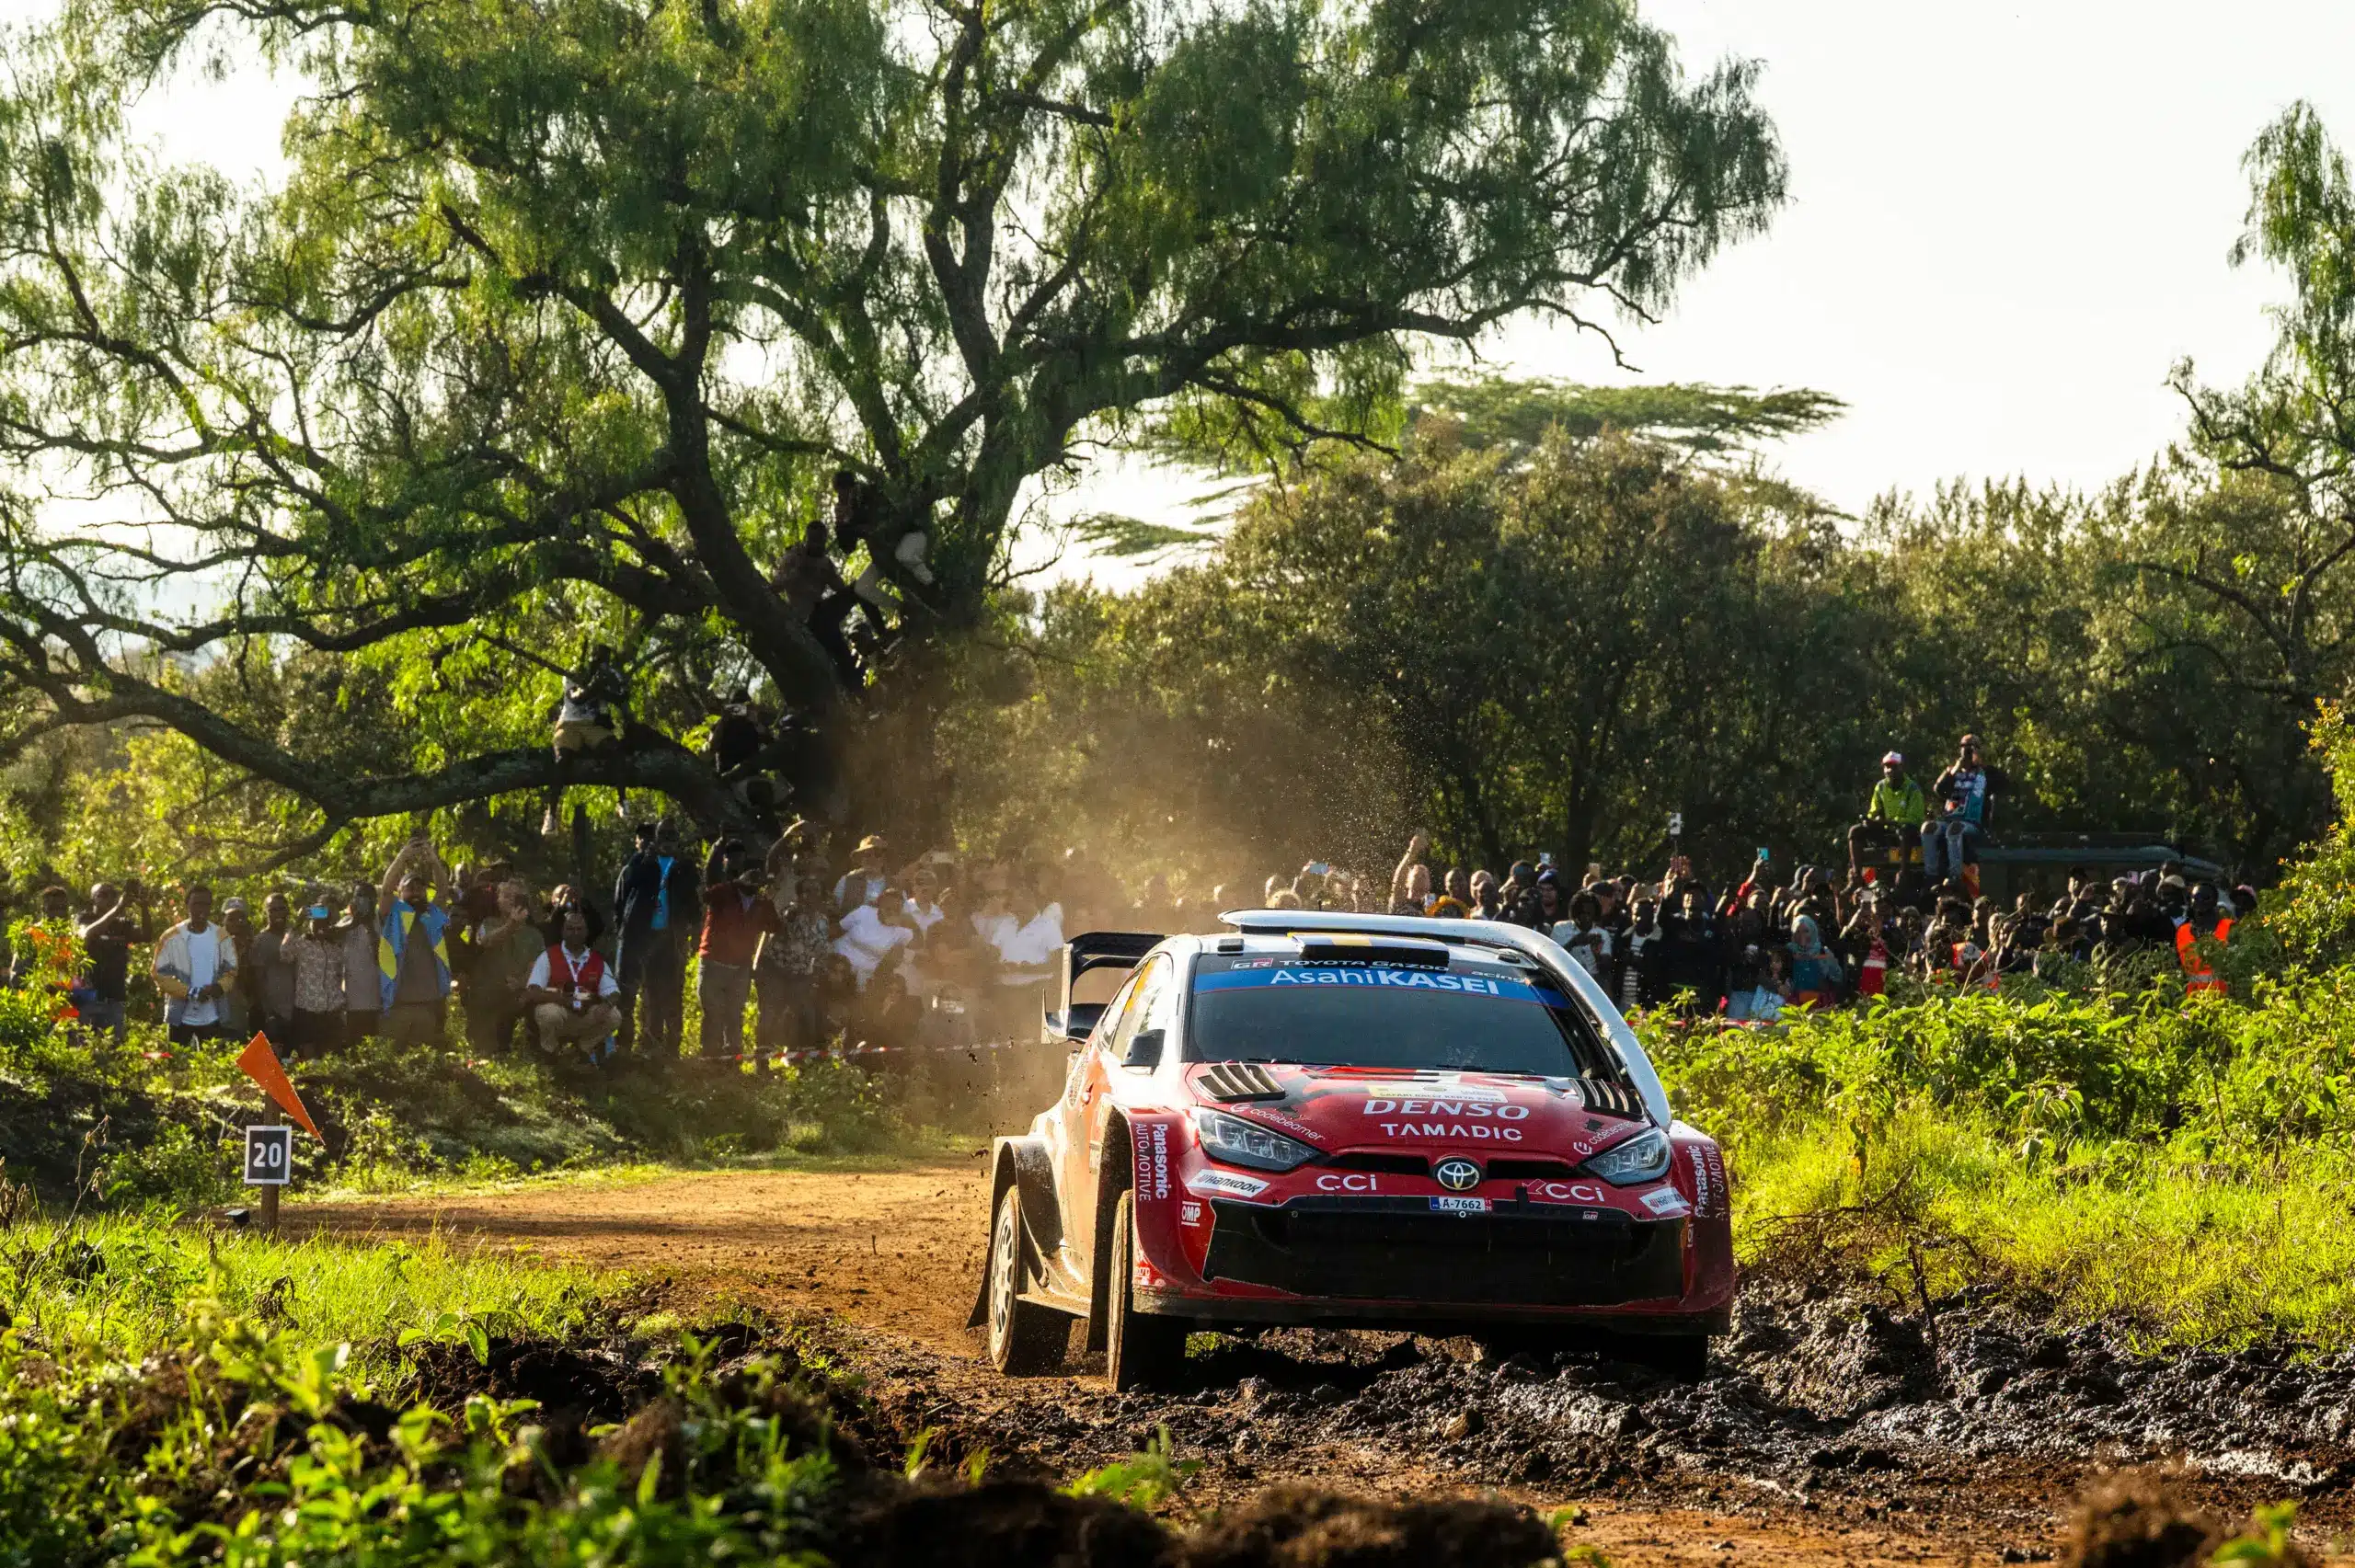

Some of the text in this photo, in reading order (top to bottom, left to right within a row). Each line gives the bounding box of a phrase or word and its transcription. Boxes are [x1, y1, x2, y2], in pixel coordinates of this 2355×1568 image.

[1232, 959, 1272, 969] GR
[1370, 960, 1450, 971] GAZOO
[1363, 1100, 1530, 1120] DENSO
[1250, 1108, 1325, 1140] codebeamer
[1381, 1123, 1523, 1141] TAMADIC
[253, 1142, 282, 1168] 20
[1152, 1123, 1172, 1200] Panasonic
[1181, 1205, 1201, 1222] OMP
[1442, 1198, 1482, 1210] A-7662
